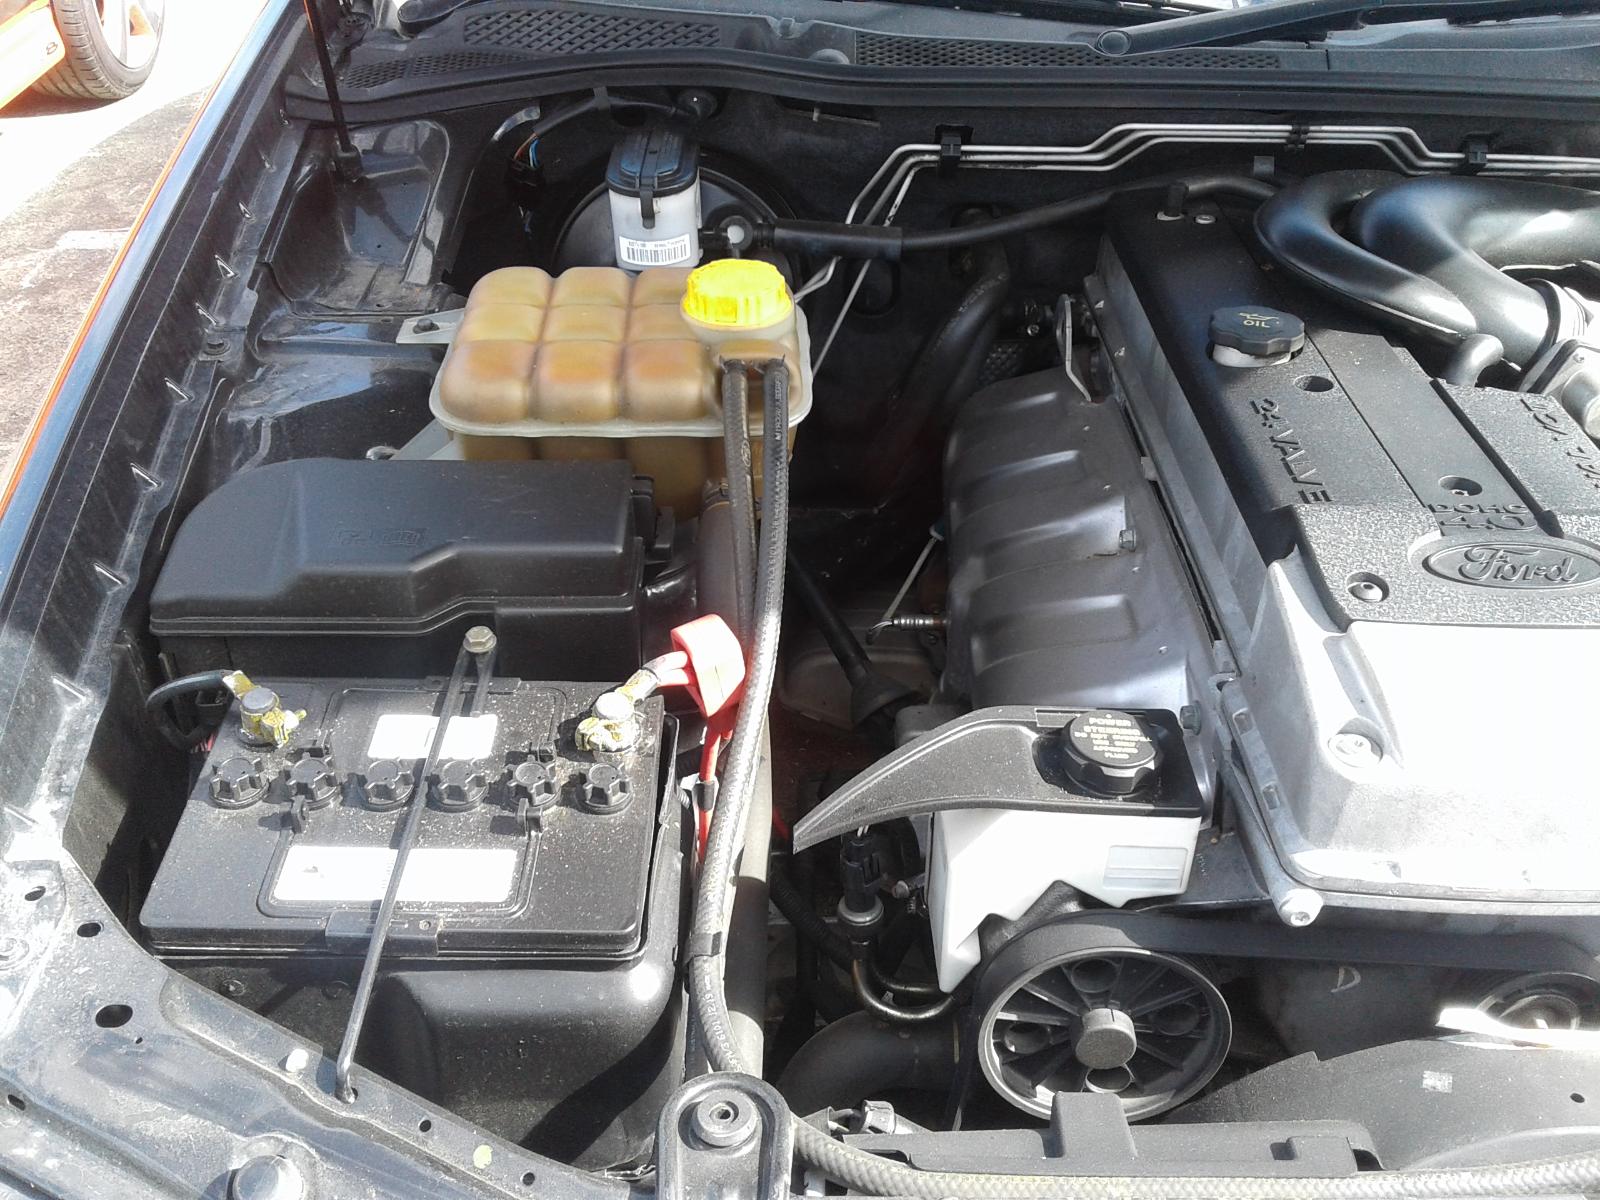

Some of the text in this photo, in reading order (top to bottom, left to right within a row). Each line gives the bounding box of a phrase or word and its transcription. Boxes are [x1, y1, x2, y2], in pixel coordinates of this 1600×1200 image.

[1242, 318, 1271, 329] OIL
[1250, 398, 1333, 505] 24 VALVE
[1427, 502, 1529, 515] DOHC
[1439, 515, 1538, 532] 4.0
[1457, 546, 1579, 584] Ford
[1089, 717, 1131, 727] POWER
